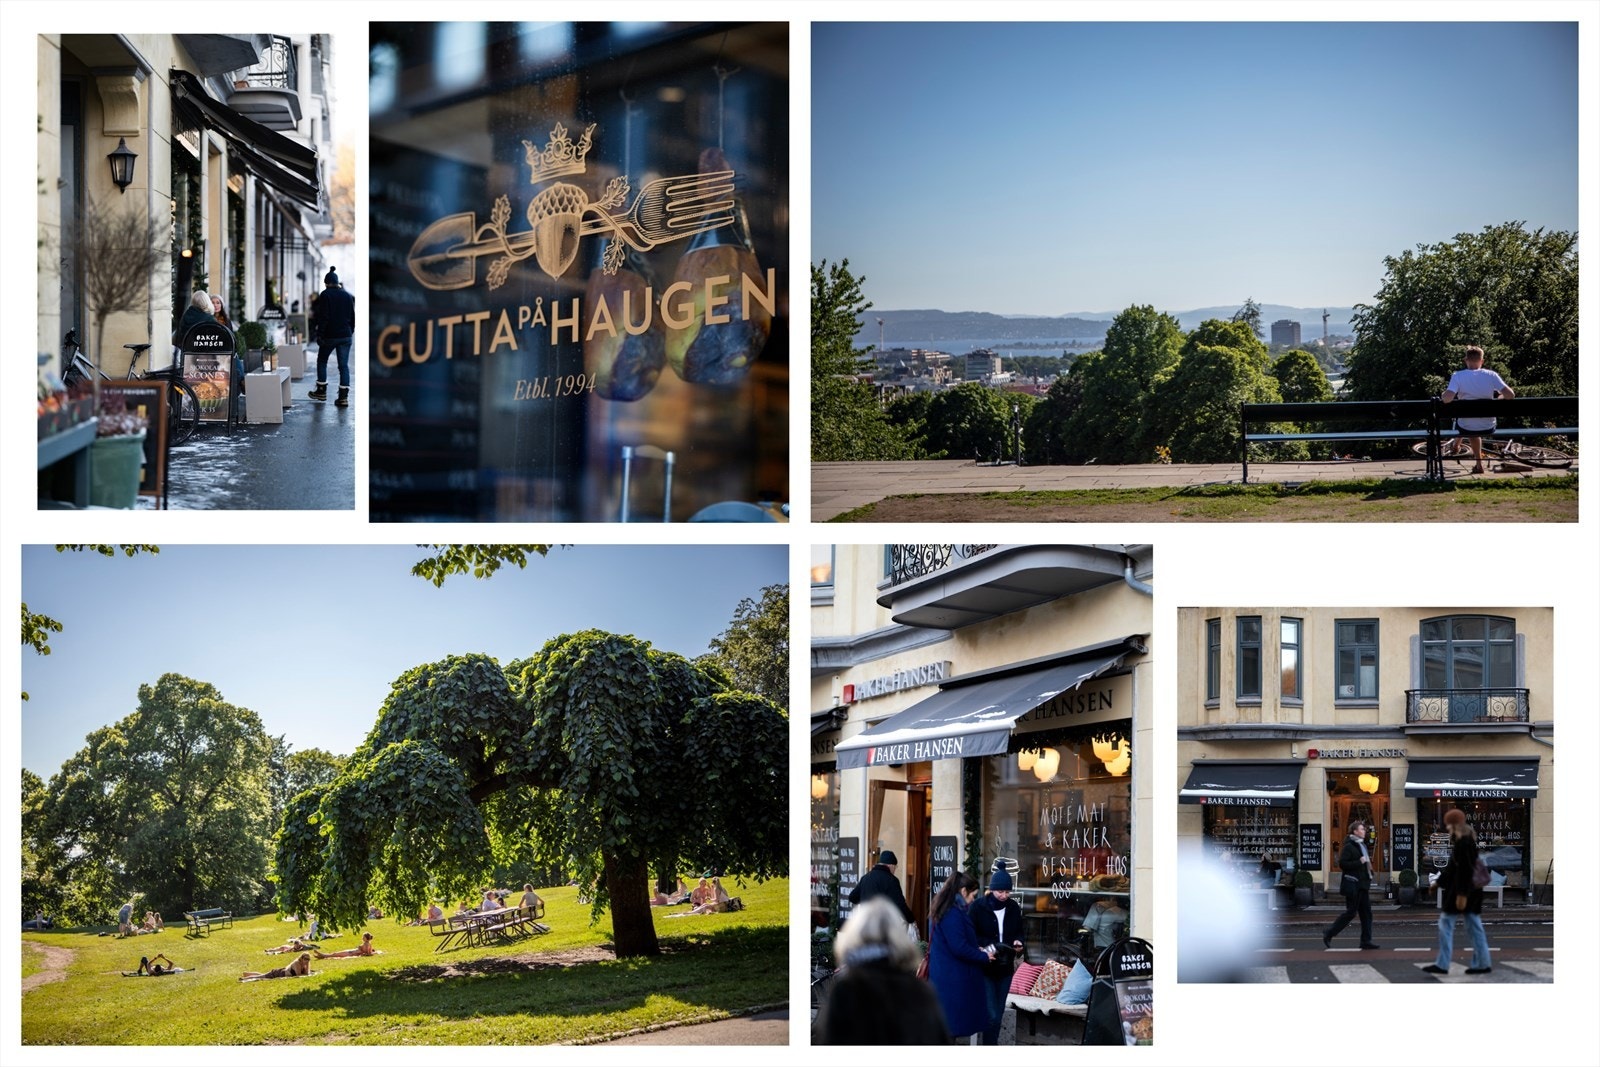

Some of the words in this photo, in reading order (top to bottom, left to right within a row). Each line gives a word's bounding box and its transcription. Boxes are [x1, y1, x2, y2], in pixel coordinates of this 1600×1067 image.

[376, 309, 518, 368] GUTTA
[518, 296, 547, 330] PÅ
[551, 267, 776, 346] HAUGEN
[189, 371, 225, 380] SCONES
[555, 372, 596, 399] 1994
[854, 676, 888, 700] BAKER
[891, 661, 945, 692] HANSEN
[1035, 689, 1114, 720] HANSEN
[876, 743, 910, 763] BAKER
[914, 737, 964, 759] HANSEN
[1319, 749, 1357, 759] BAKER
[1359, 749, 1407, 759] HANSEN
[1207, 797, 1234, 805] BAKER
[1237, 798, 1271, 806] HANSEN
[1480, 821, 1511, 830] KAKER
[1045, 832, 1055, 849] &
[1063, 826, 1112, 849] KAKER
[1042, 854, 1099, 877] BESTILL
[1105, 855, 1128, 876] HOS
[1125, 1003, 1153, 1013] SCON
